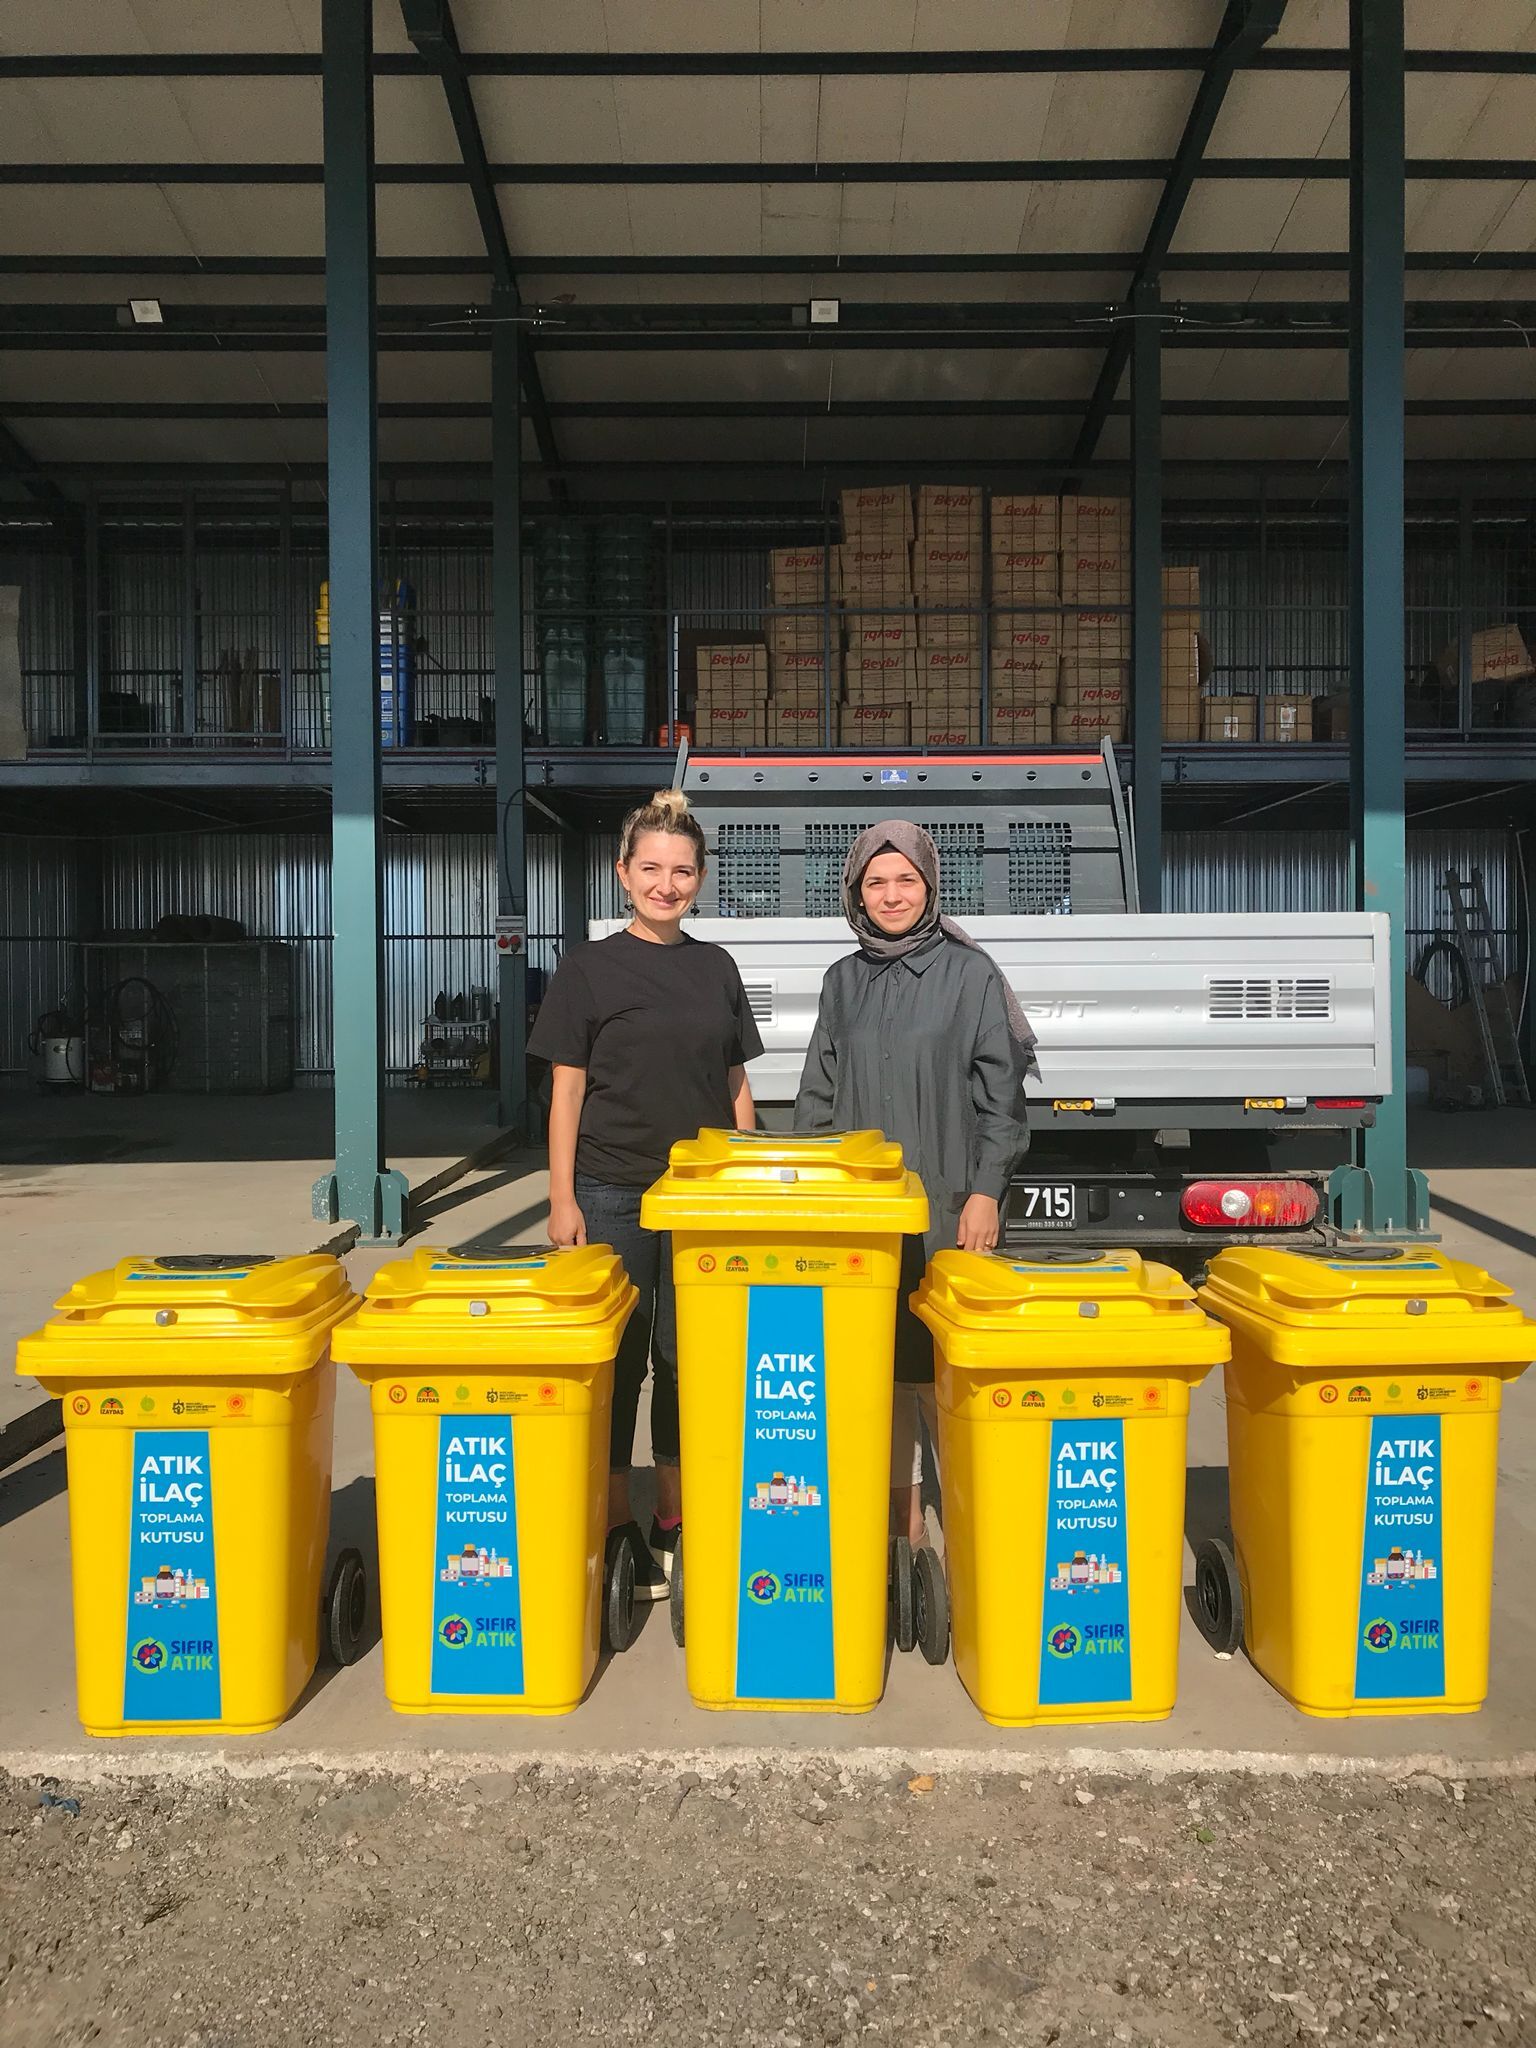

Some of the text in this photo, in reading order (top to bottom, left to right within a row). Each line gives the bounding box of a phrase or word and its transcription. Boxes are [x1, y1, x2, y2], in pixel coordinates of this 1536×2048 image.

[933, 494, 973, 507] Beybi
[1004, 504, 1043, 516] Beybi
[1077, 505, 1116, 517] Beybi
[785, 555, 823, 567] Beybi
[854, 549, 893, 562] Beybi
[928, 550, 969, 562] Beybi
[1006, 555, 1044, 567] Beybi
[1077, 559, 1116, 571] Beybi
[864, 629, 902, 642] Beybi
[711, 653, 751, 666] Beybi
[862, 657, 899, 669] Beybi
[930, 654, 969, 665] Beybi
[1003, 659, 1043, 672] Beybi
[1082, 689, 1121, 701] Beybi
[709, 708, 749, 720] Beybi
[853, 708, 893, 720] Beybi
[1071, 715, 1110, 727] Beybi
[928, 733, 967, 745] Beybi
[1020, 1000, 1098, 1018] SIT
[1023, 1187, 1070, 1217] 715
[755, 1353, 816, 1372] ATIK
[755, 1374, 816, 1405] İLAÇ
[755, 1410, 816, 1420] TOPLAMA
[755, 1428, 816, 1440] KUTUSU
[445, 1437, 506, 1455] ATIK
[1057, 1441, 1117, 1461] ATIK
[1376, 1440, 1435, 1458] ATIK
[140, 1456, 203, 1474] ATIK
[445, 1457, 507, 1488] İLAÇ
[1057, 1463, 1117, 1493] İLAÇ
[1375, 1461, 1434, 1490] İLAÇ
[140, 1477, 203, 1508] İLAÇ
[445, 1493, 507, 1503] TOPLAMA
[1056, 1499, 1118, 1509] TOPLAMA
[1374, 1496, 1434, 1506] TOPLAMA
[139, 1513, 204, 1523] TOPLAMA
[446, 1511, 507, 1522] KUTUSU
[1056, 1516, 1117, 1529] KUTUSU
[1374, 1513, 1434, 1525] KUTUSU
[140, 1531, 204, 1543] KUTUSU
[784, 1573, 825, 1587] SIFIR
[784, 1588, 825, 1603] ATIK
[475, 1617, 516, 1631] SIFIR
[1400, 1619, 1439, 1634] SIFIR
[1084, 1624, 1124, 1638] SIFIR
[475, 1632, 516, 1647] ATIK
[1084, 1638, 1124, 1654] ATIK
[1400, 1634, 1439, 1649] ATIK
[171, 1640, 213, 1654] SIFIR
[171, 1655, 213, 1671] ATIK
